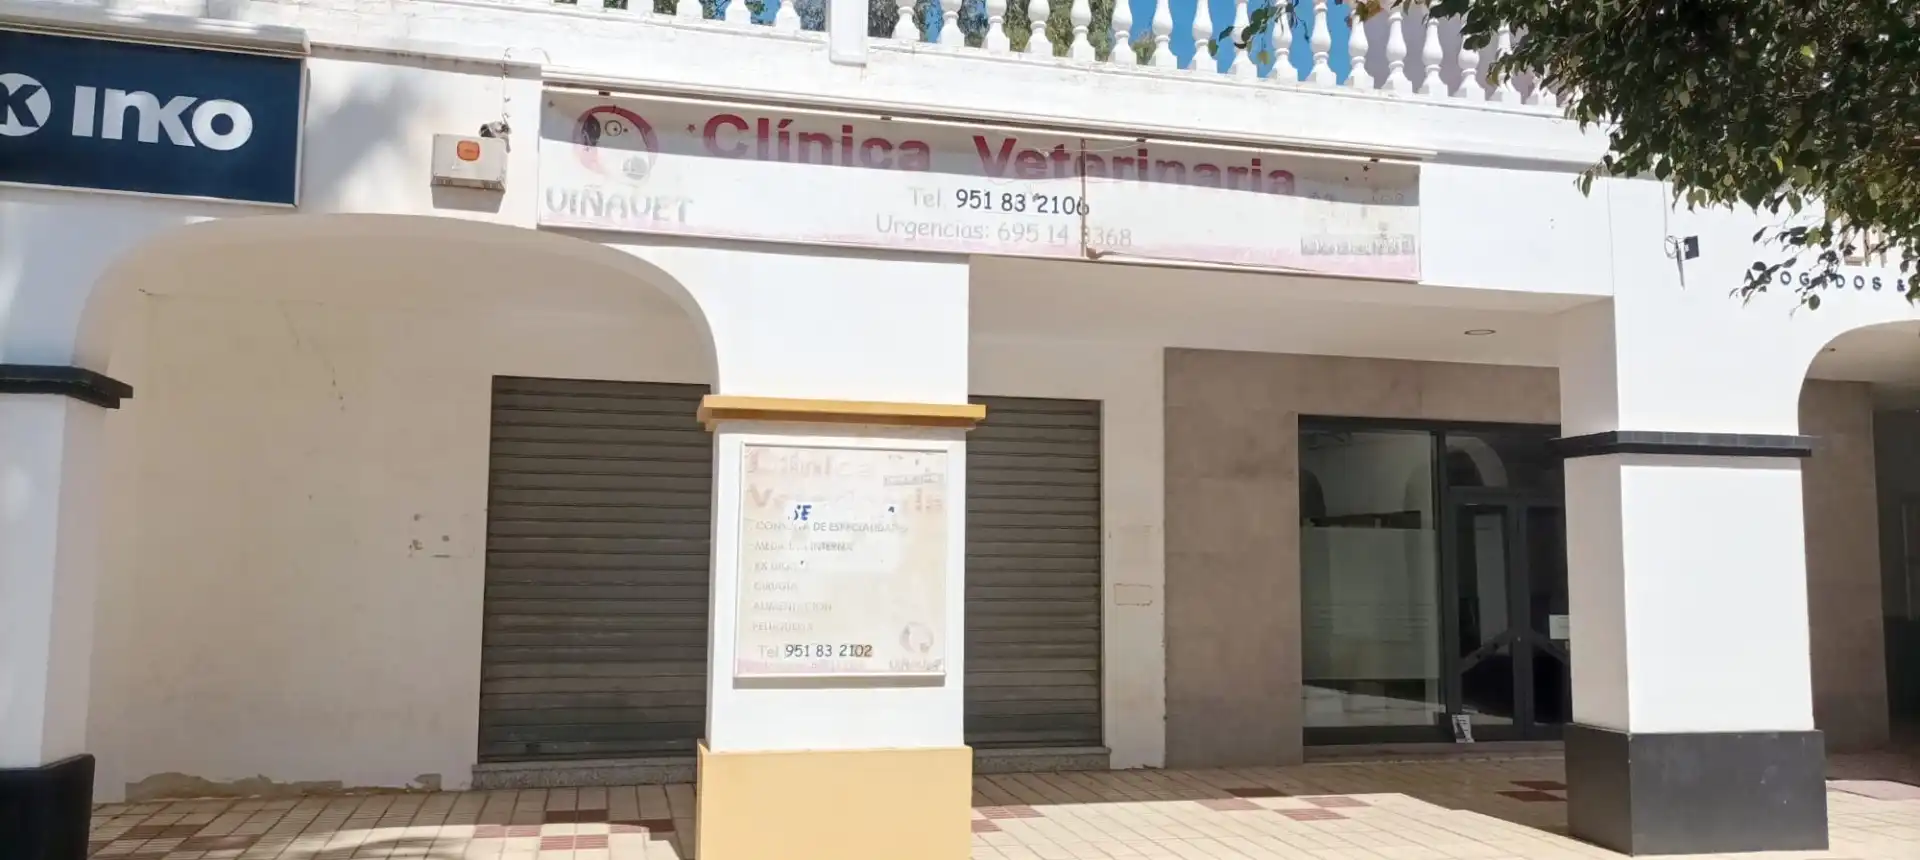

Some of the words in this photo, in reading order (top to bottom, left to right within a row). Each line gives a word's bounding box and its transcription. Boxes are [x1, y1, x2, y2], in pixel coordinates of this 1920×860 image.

[703, 114, 931, 171] Clínica
[973, 135, 1295, 196] Veterinaria
[956, 188, 993, 210] 951
[1001, 192, 1027, 213] 83
[1036, 194, 1090, 216] 2106
[875, 213, 990, 240] Urgencias:
[997, 221, 1040, 243] 695
[1047, 223, 1069, 246] 14
[1744, 269, 1882, 291] AOGDOS
[813, 521, 826, 532] DE
[785, 643, 810, 658] 951
[815, 643, 833, 658] 83
[839, 643, 873, 658] 2102
